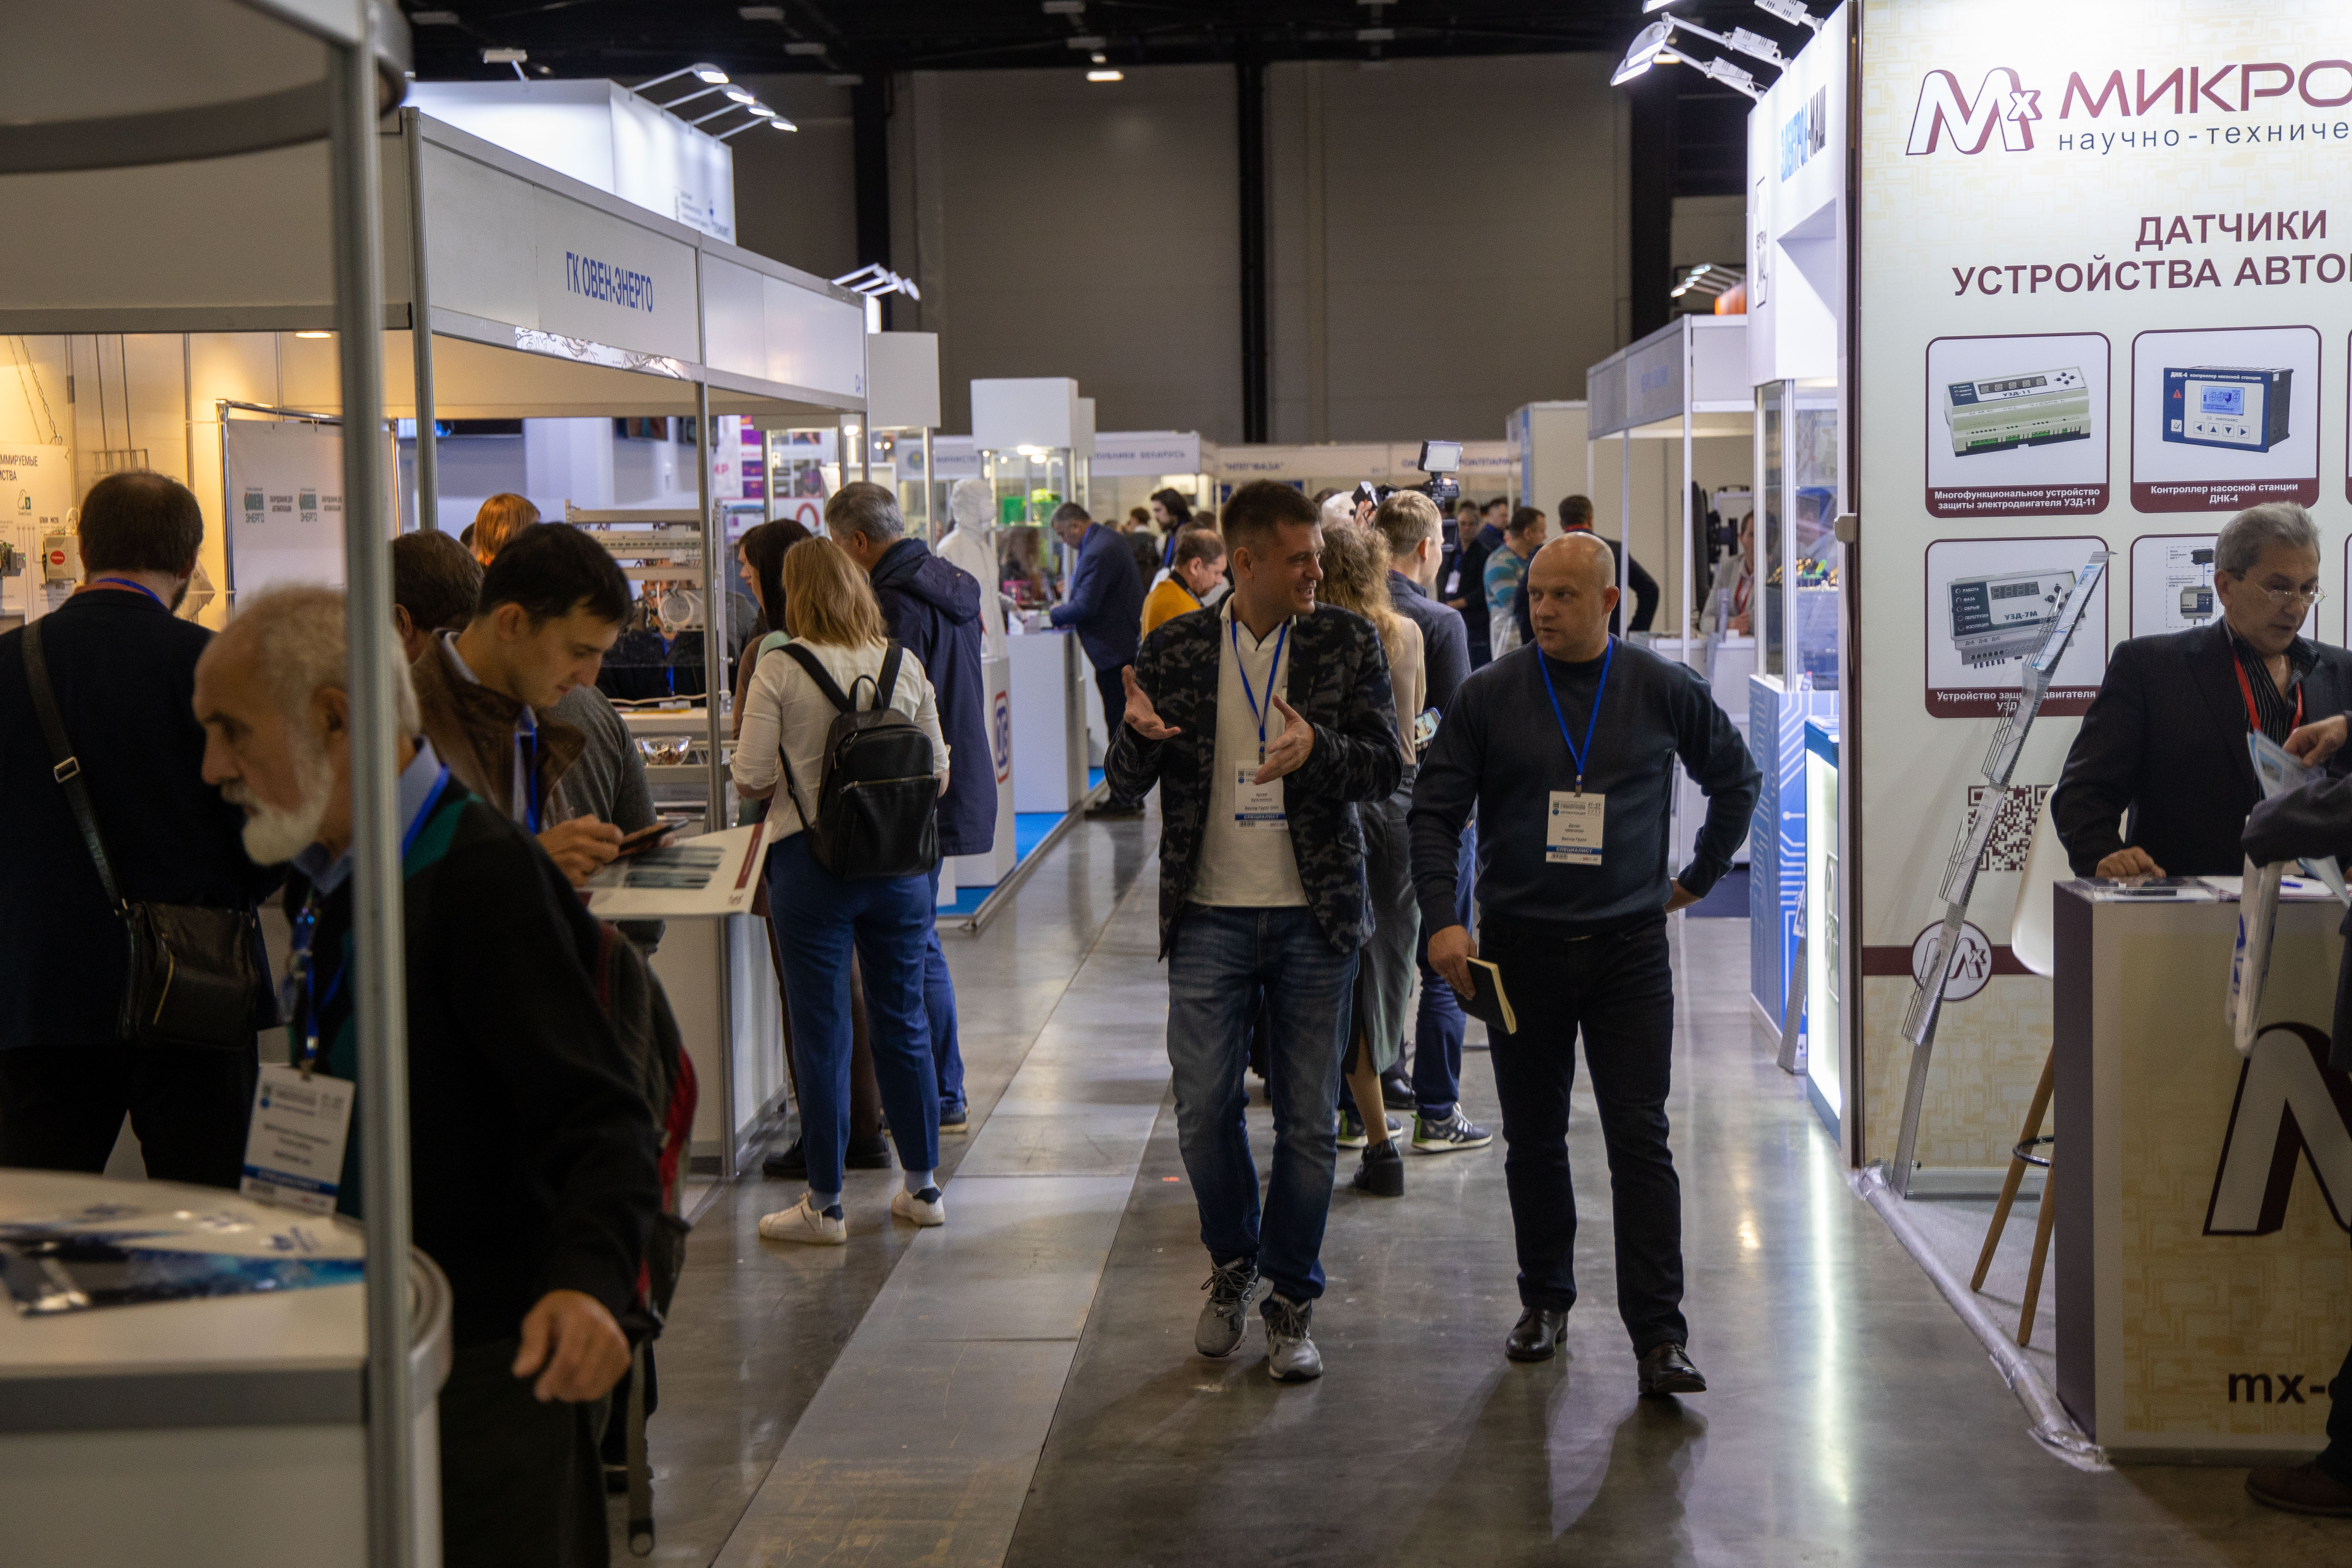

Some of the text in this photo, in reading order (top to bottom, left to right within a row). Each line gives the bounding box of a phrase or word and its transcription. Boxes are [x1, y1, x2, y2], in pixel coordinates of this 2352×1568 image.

[2059, 59, 2352, 119] МИКРО
[2059, 121, 2349, 155] научно-техниче
[2135, 209, 2328, 251] ДАТЧИКИ
[1951, 253, 2352, 296] УСТРОЙСТВА АВТО
[566, 251, 653, 312] ГК ОВЕН-ЭНЕРГО
[1935, 488, 2100, 501] Многофункциональное устройство
[2151, 483, 2298, 495] Контроллер насосной станции
[1938, 497, 2095, 509] защиты электродвигателя УЗД-11
[2209, 494, 2239, 504] ДНК-4
[2004, 610, 2038, 620] УЗД-7М
[1937, 692, 1996, 701] Устройство
